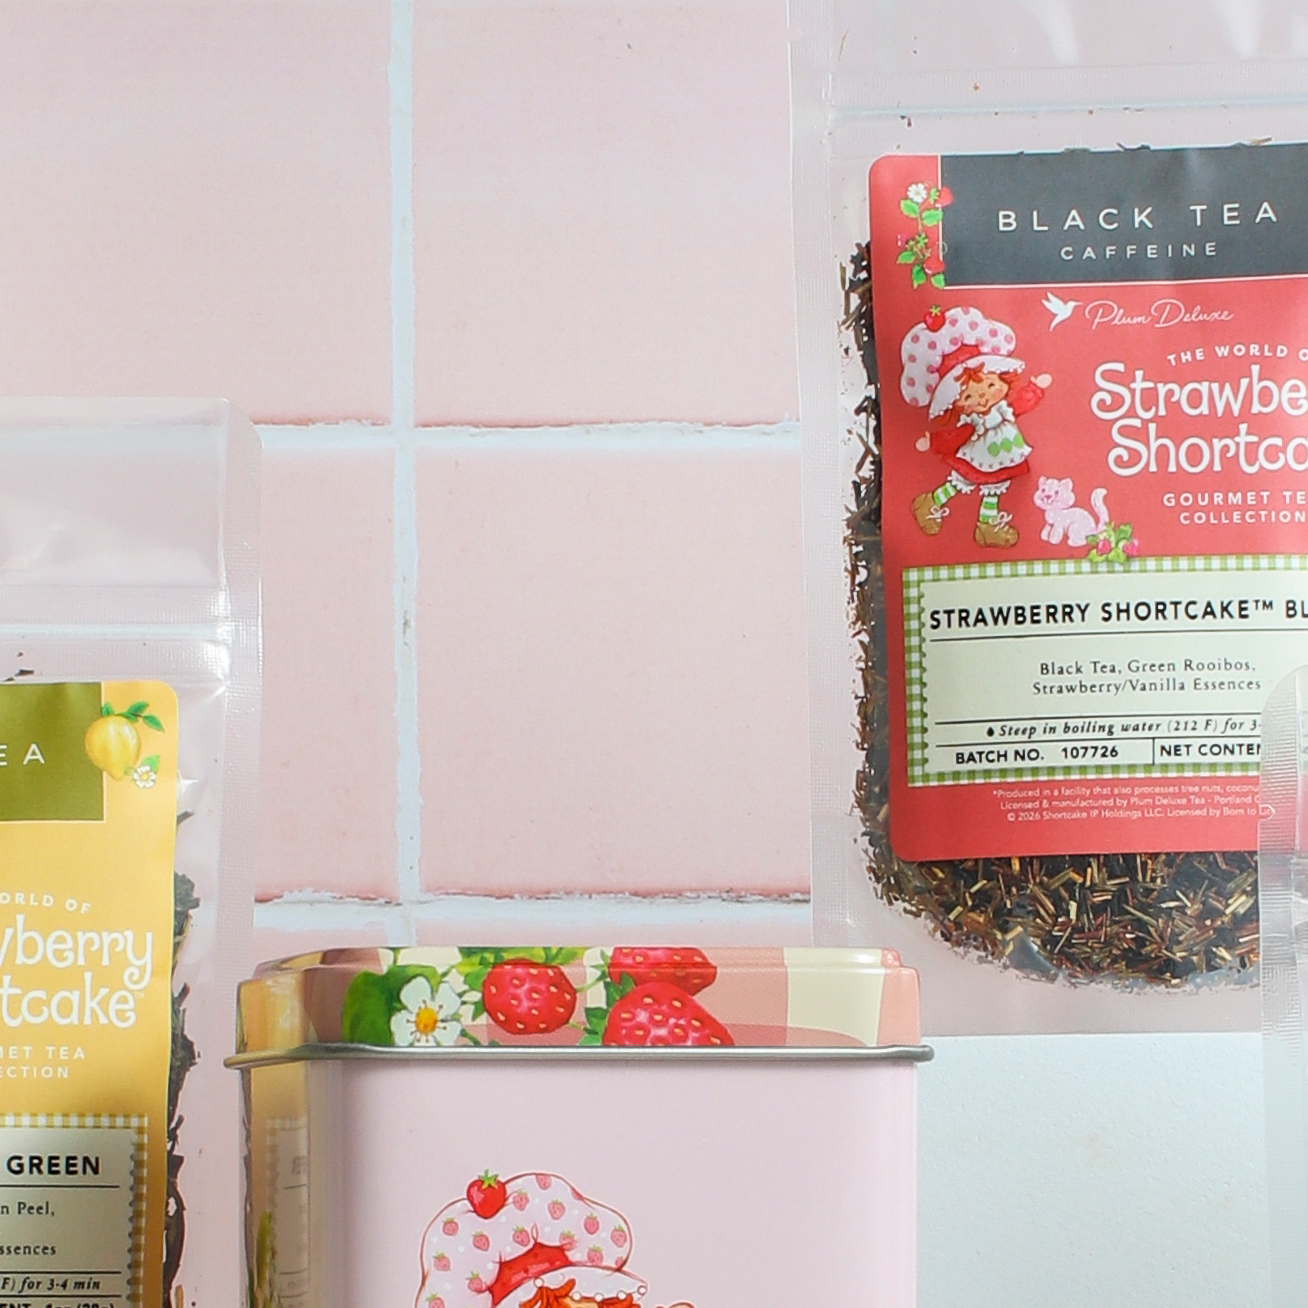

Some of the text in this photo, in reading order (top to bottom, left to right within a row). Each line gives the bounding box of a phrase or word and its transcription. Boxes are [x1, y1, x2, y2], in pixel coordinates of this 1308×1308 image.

[998, 202, 1278, 231] BLACK TEA
[1060, 242, 1218, 260] CAFFEINE
[1086, 299, 1234, 330] Plum Deluxe
[1167, 348, 1206, 366] THE
[1216, 344, 1288, 359] WORLD
[1164, 491, 1270, 507] GOURMET
[1179, 510, 1306, 524] COLLECTION
[930, 603, 1090, 629] STRAWBERRY
[1041, 659, 1256, 675] Black Tea, Green Rooibos,
[1033, 678, 1261, 696] Strawberry/Vanilla Essences
[999, 725, 1036, 738] Steep
[1043, 725, 1056, 735] in
[1063, 723, 1114, 736] boiling
[1121, 723, 1161, 732] water
[1167, 718, 1200, 732] (212
[1204, 718, 1218, 733] F)
[1221, 718, 1244, 734] for
[956, 746, 1119, 764] BATCH NO. 107726
[1160, 744, 1192, 756] NET
[1198, 743, 1261, 756] CONTE
[65, 898, 91, 914] OF
[46, 1046, 85, 1060] TEA
[7, 1155, 100, 1175] GREEN
[17, 1201, 55, 1216] Peel,
[1, 1277, 16, 1291] F)
[18, 1277, 43, 1293] for
[47, 1278, 68, 1289] 3-4
[73, 1278, 101, 1290] min
